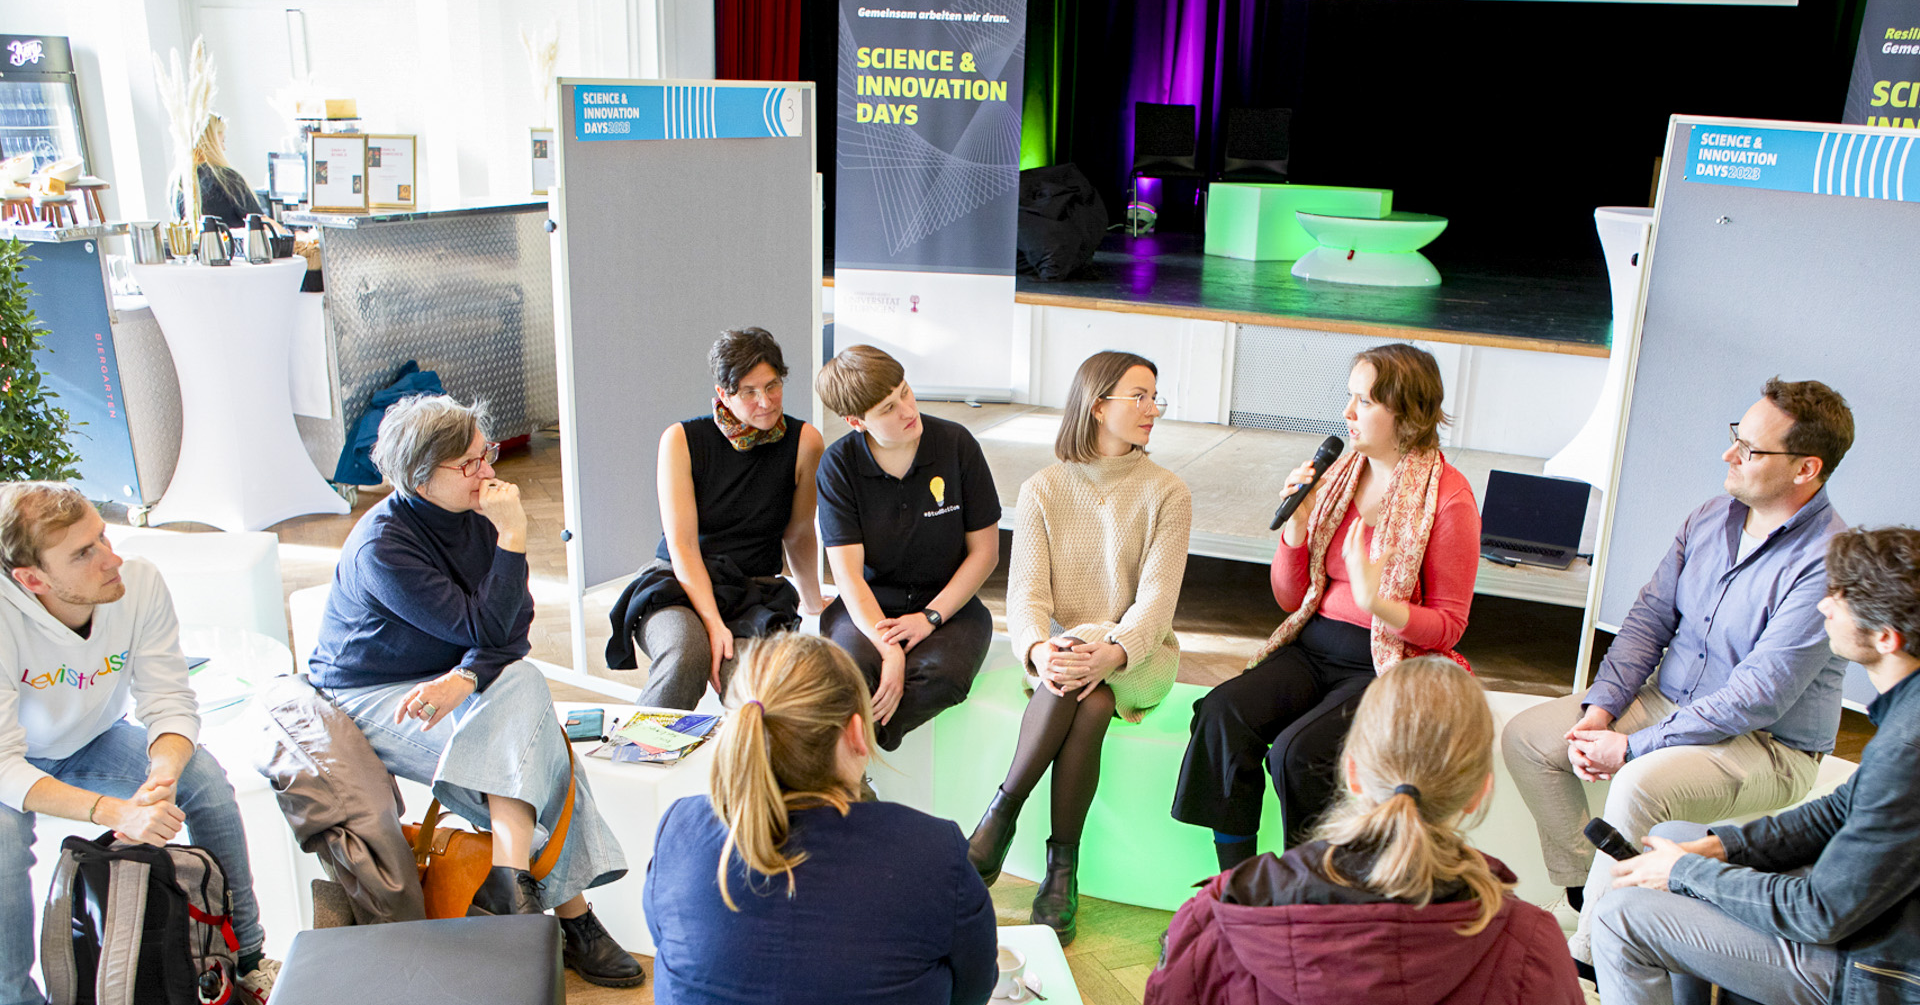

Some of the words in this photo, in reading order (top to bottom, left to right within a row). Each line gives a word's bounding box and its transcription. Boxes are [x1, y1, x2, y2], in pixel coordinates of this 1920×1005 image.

[857, 6, 917, 19] Gemeinsam
[918, 10, 962, 22] arbeiten
[963, 12, 981, 22] wir
[982, 13, 1010, 24] dran.
[856, 46, 954, 71] SCIENCE
[959, 51, 977, 73] &
[583, 92, 620, 104] SCIENCE
[621, 92, 629, 104] &
[856, 75, 1008, 102] INNOVATION
[584, 107, 640, 119] INNOVATION
[856, 102, 919, 126] DAYS
[1700, 132, 1752, 149] SCIENCE
[1753, 136, 1763, 150] &
[1698, 147, 1778, 167] INNOVATION
[94, 333, 117, 419] BIERGARTEN
